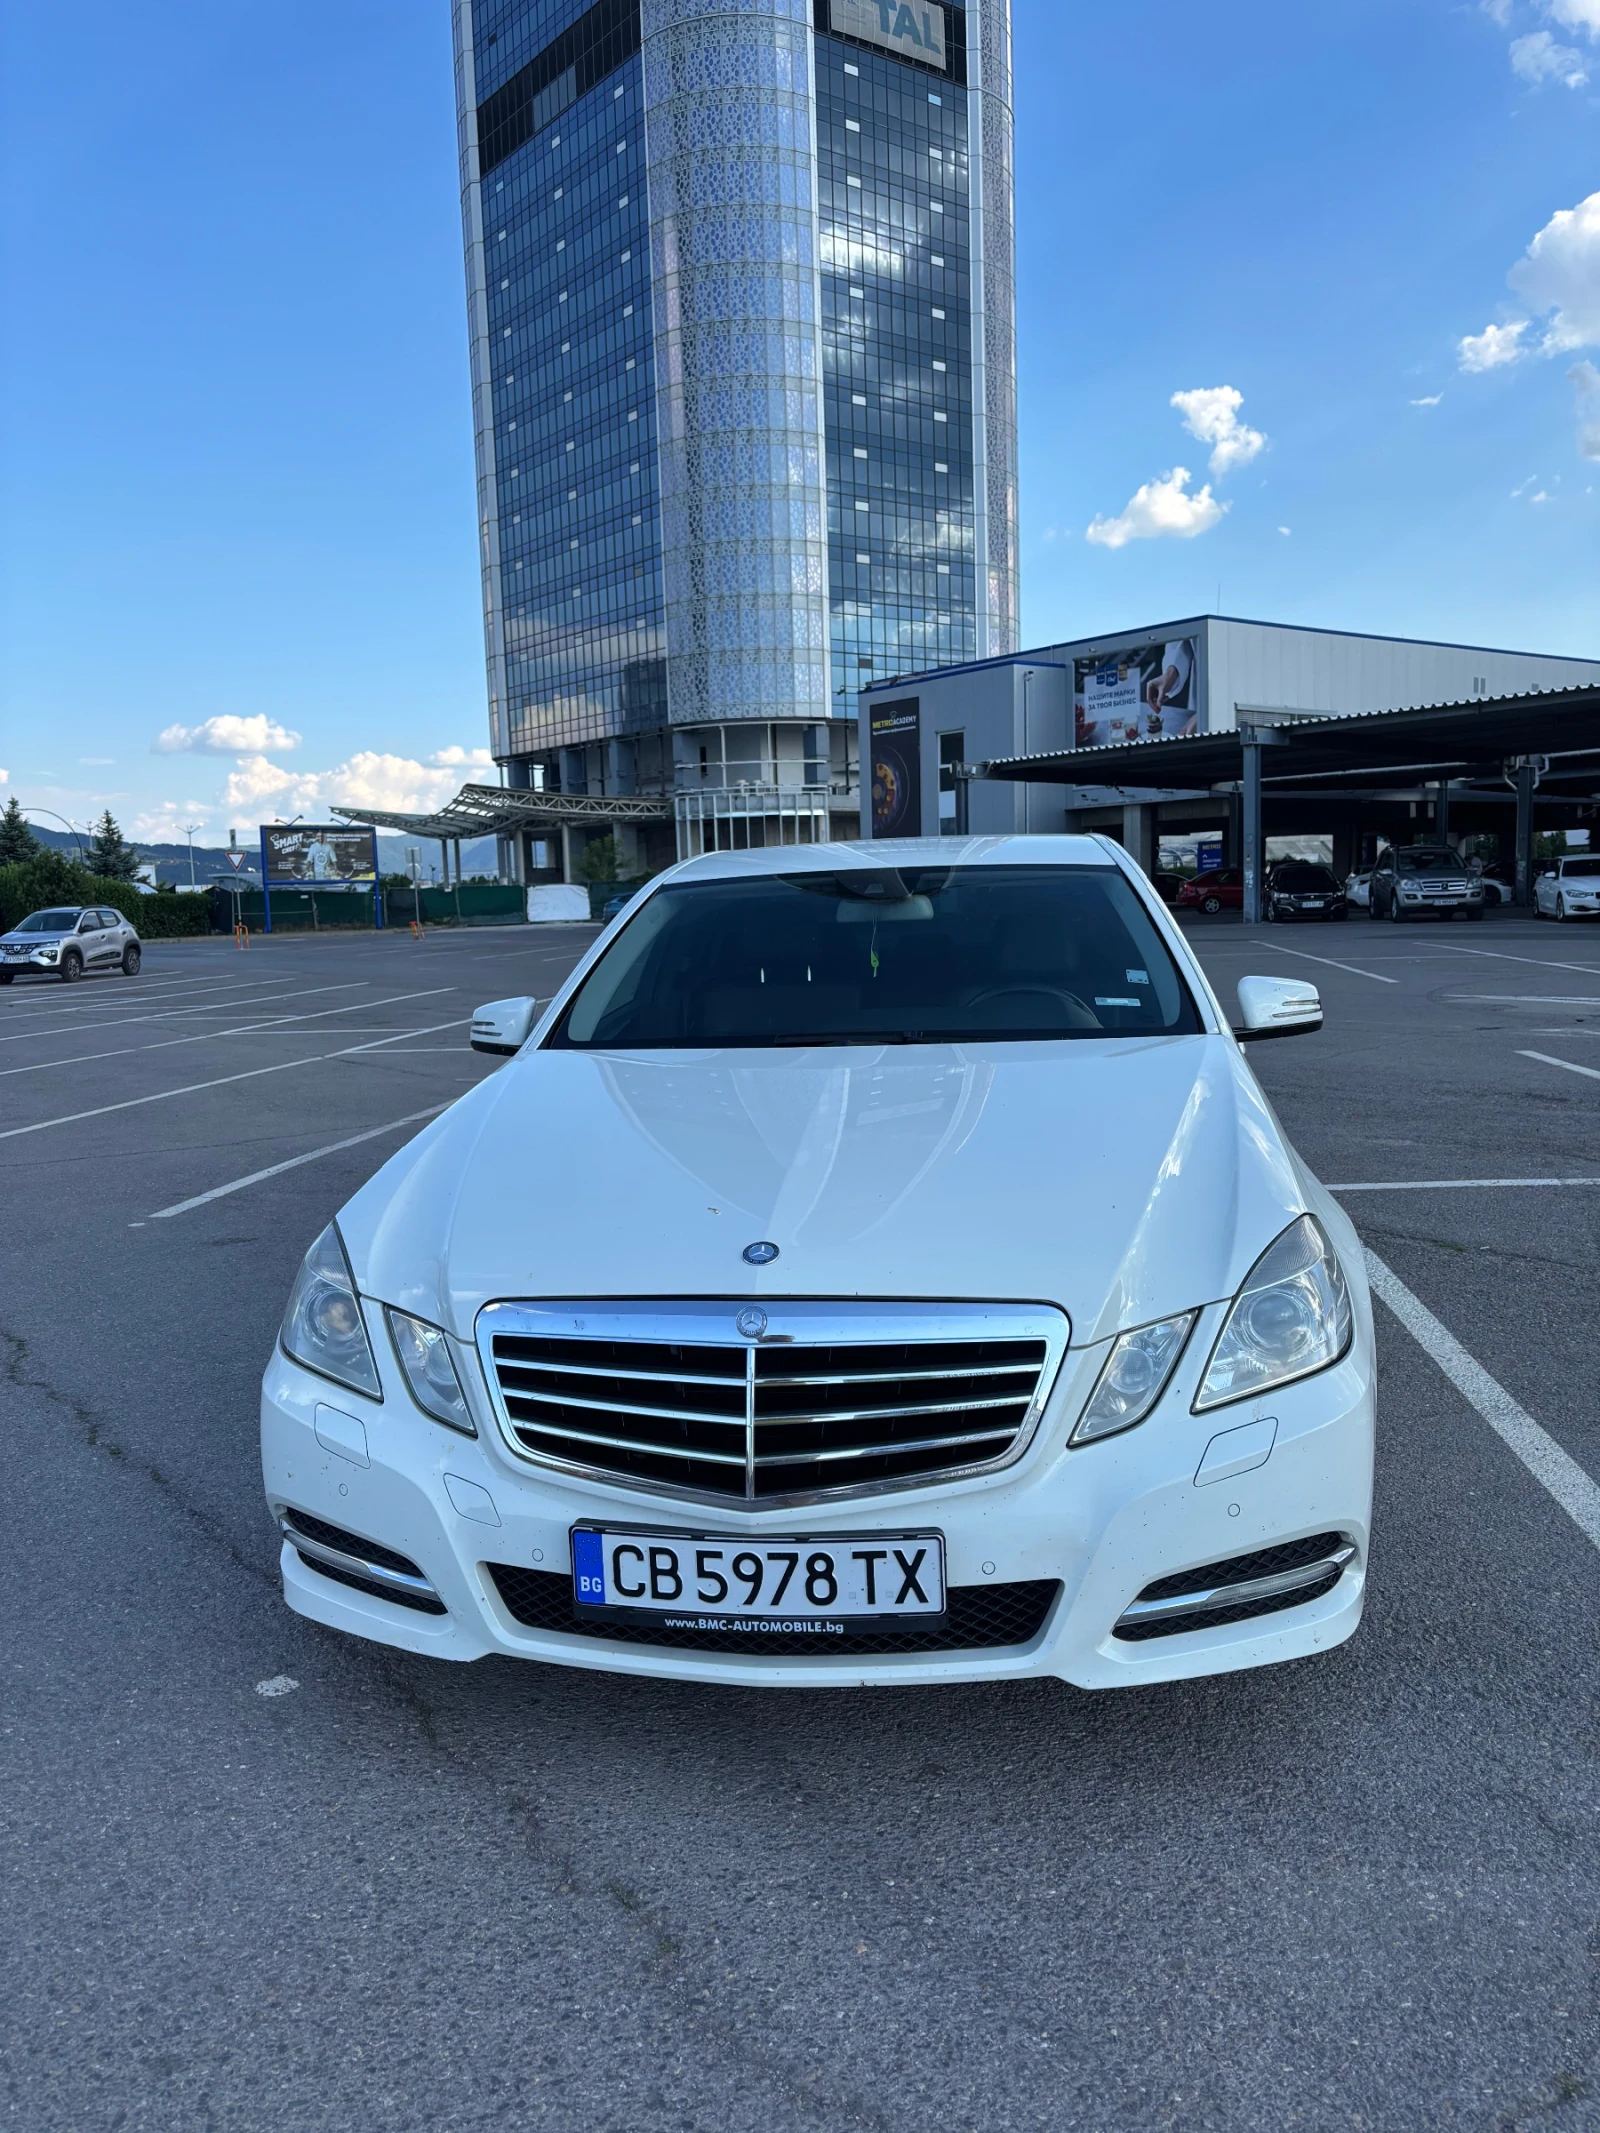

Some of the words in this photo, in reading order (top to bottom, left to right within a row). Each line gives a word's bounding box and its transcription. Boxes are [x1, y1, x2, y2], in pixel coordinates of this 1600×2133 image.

[1088, 692, 1113, 702] НАШИТЕ
[1114, 689, 1135, 698] МАРКИ
[1097, 701, 1113, 710] ТВОЯ
[1113, 698, 1136, 707] БИЗНЕС
[273, 833, 304, 850] SMART
[579, 1576, 602, 1594] BG
[695, 1549, 838, 1606] 5978
[851, 1548, 929, 1605] TX
[664, 1618, 844, 1634] www.BMC-AUTOMOBILE.bg
